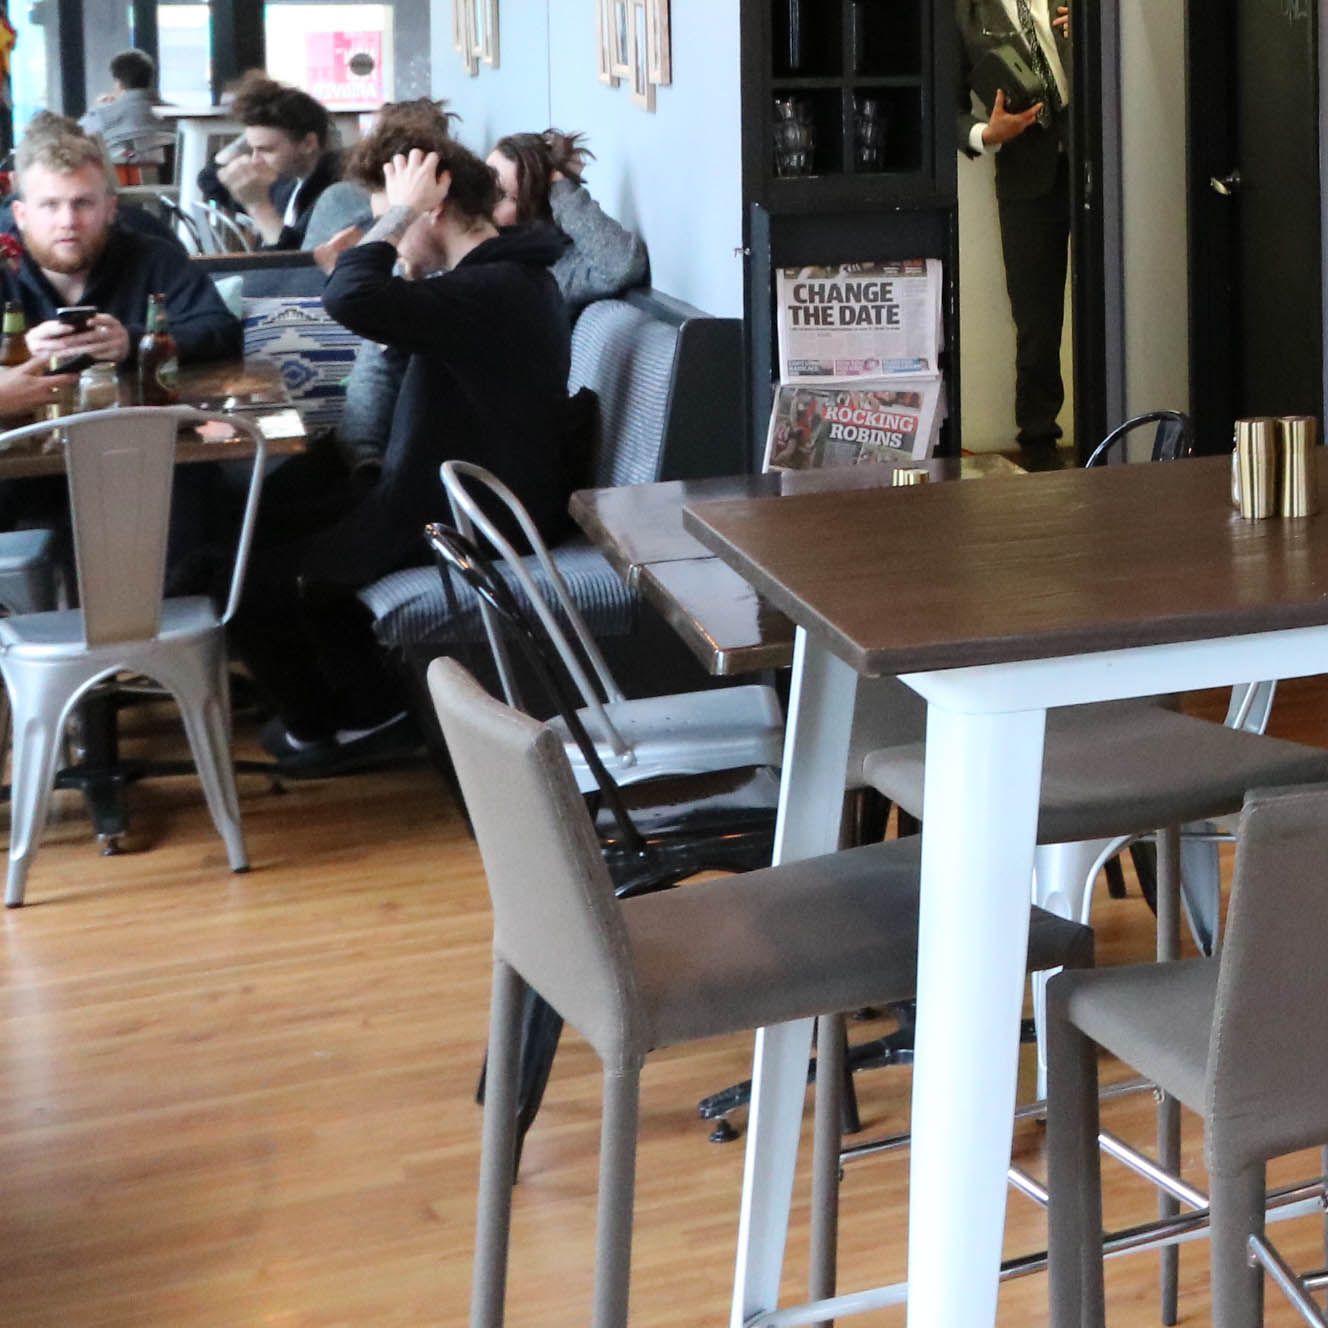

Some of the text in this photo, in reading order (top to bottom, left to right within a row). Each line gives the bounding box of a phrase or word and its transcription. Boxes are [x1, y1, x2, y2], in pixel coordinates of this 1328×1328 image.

[792, 282, 894, 304] CHANGE
[788, 304, 900, 326] THE DATE
[825, 406, 914, 432] ROCKING
[829, 424, 903, 448] ROBINS
